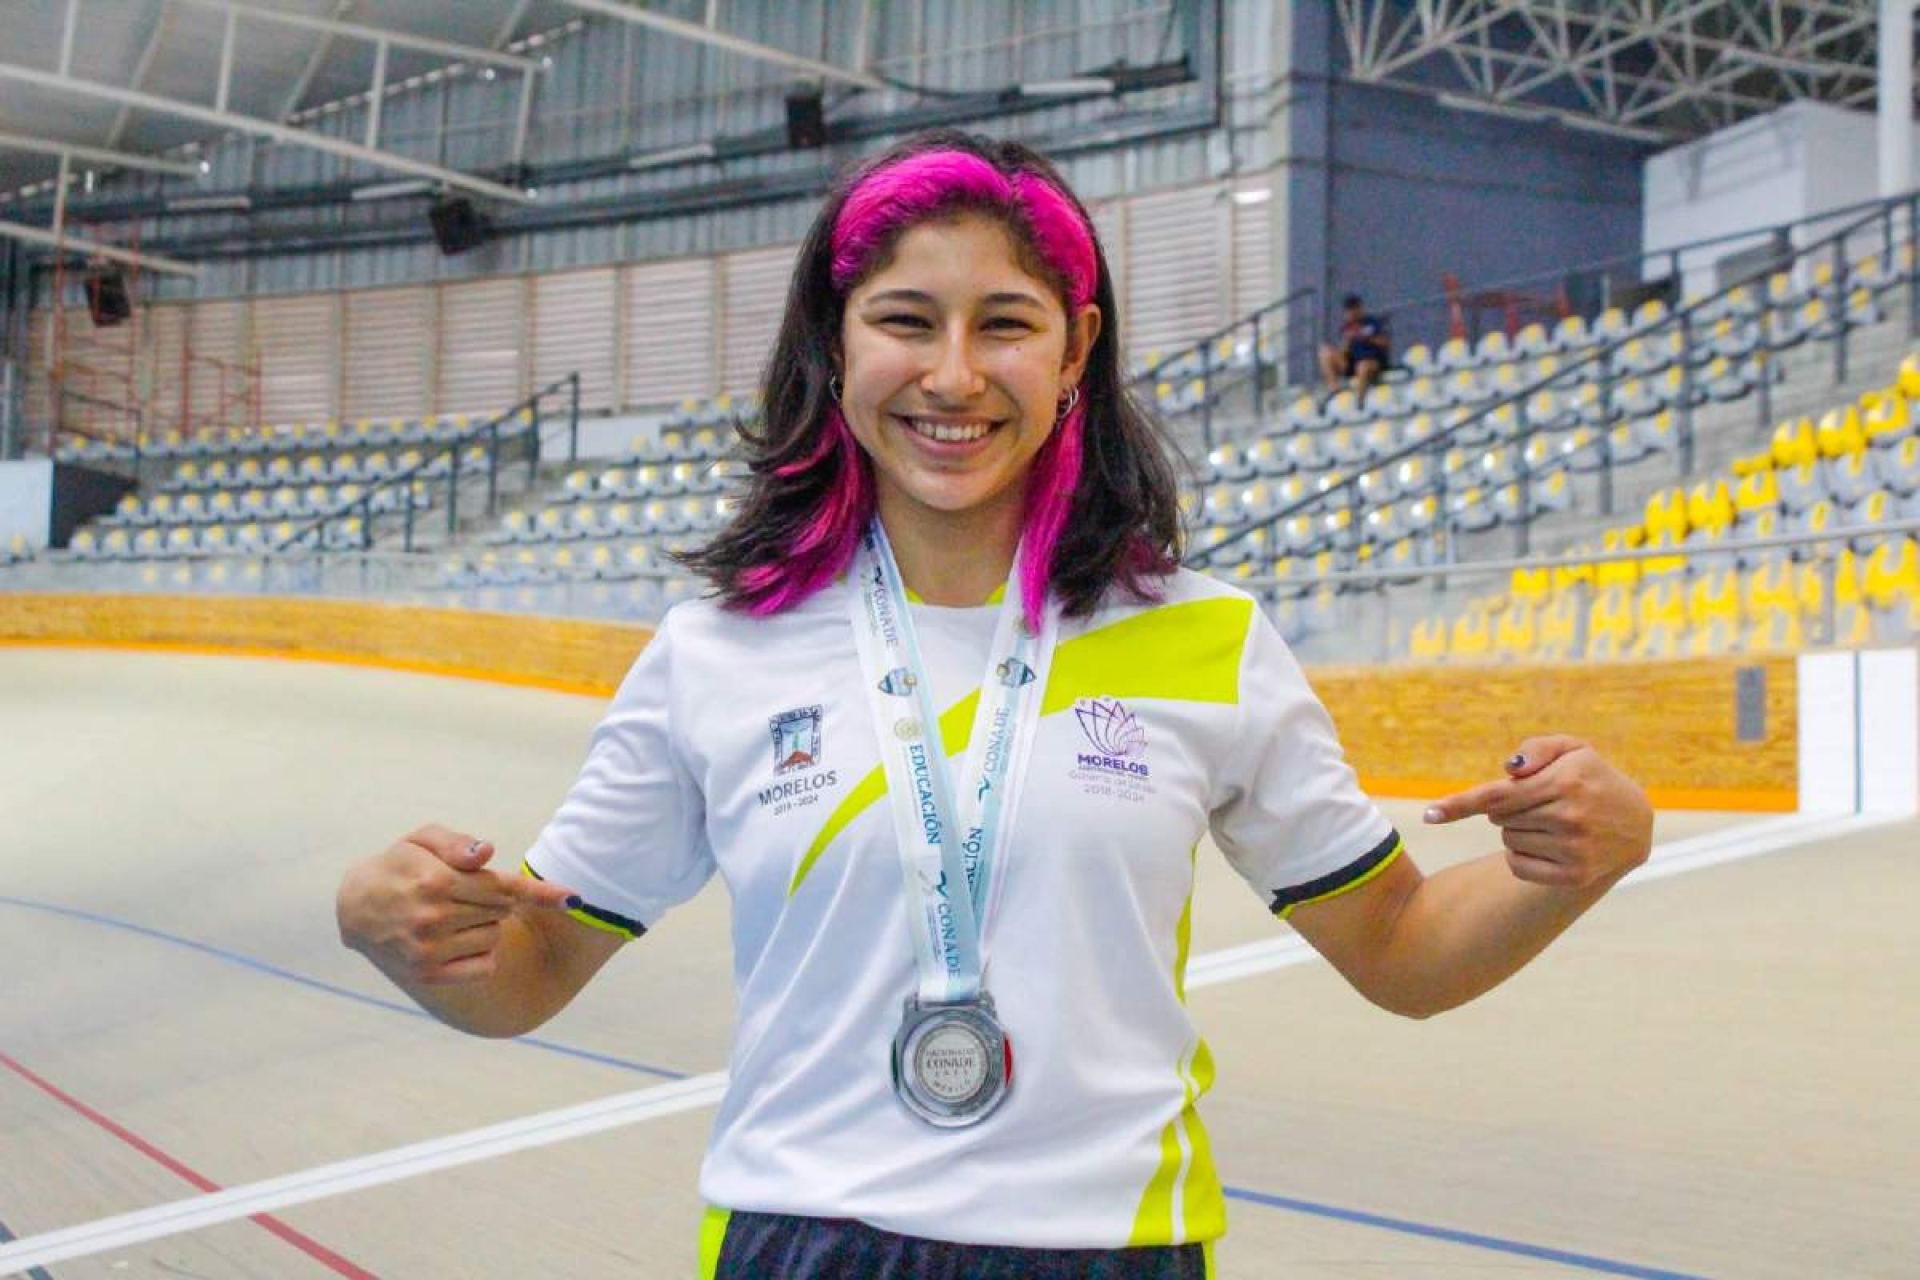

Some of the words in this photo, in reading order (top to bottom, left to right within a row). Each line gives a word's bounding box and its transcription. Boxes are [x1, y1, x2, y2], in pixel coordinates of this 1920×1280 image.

[984, 706, 1010, 773] CONADE
[1077, 753, 1148, 777] MORELOS
[757, 769, 837, 807] MORELOS
[910, 743, 942, 846] EDUCACIÓN
[938, 902, 961, 979] CONADE
